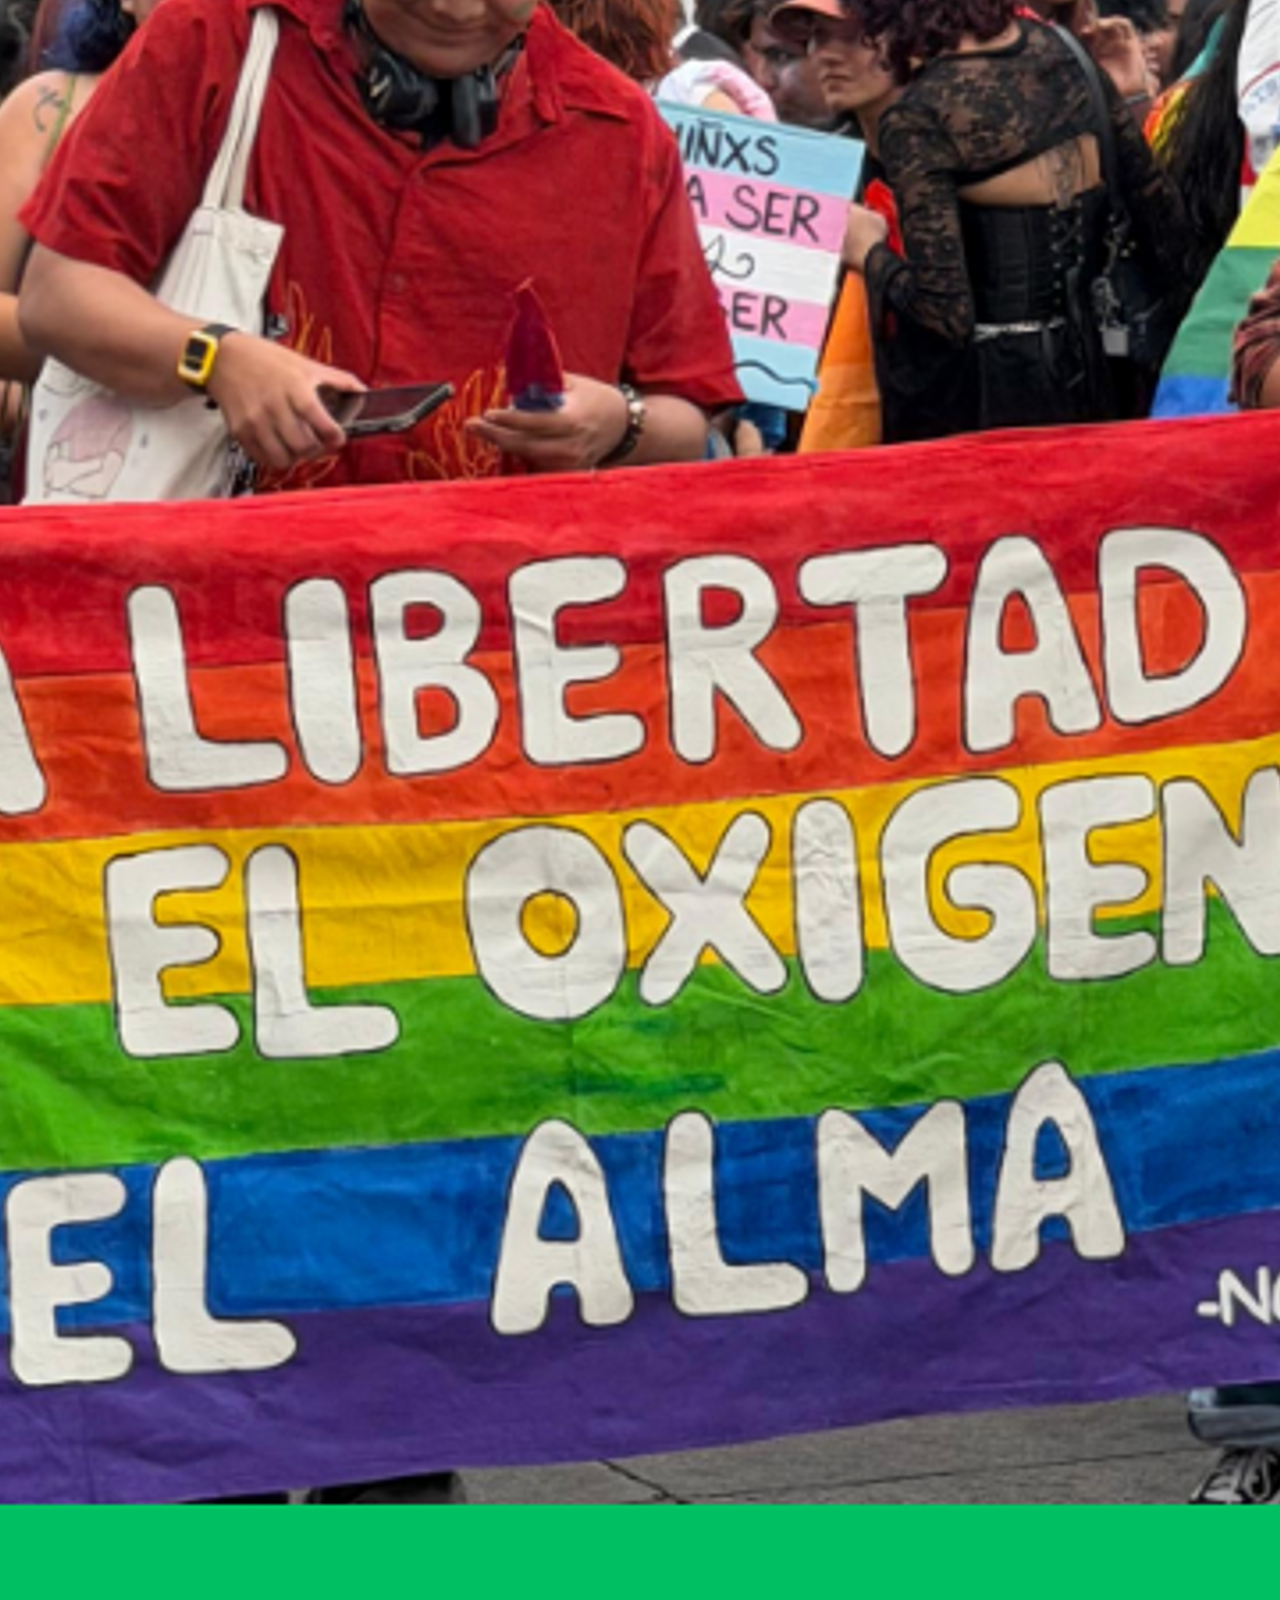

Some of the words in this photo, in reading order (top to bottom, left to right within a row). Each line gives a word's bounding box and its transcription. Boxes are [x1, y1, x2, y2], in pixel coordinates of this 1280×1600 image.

[676, 118, 780, 176] IÑXS
[725, 184, 820, 243] SER
[721, 291, 789, 341] ER
[126, 525, 1248, 792] LIBERTAD
[104, 843, 400, 1060] EL
[489, 1059, 1126, 1336] ALMA
